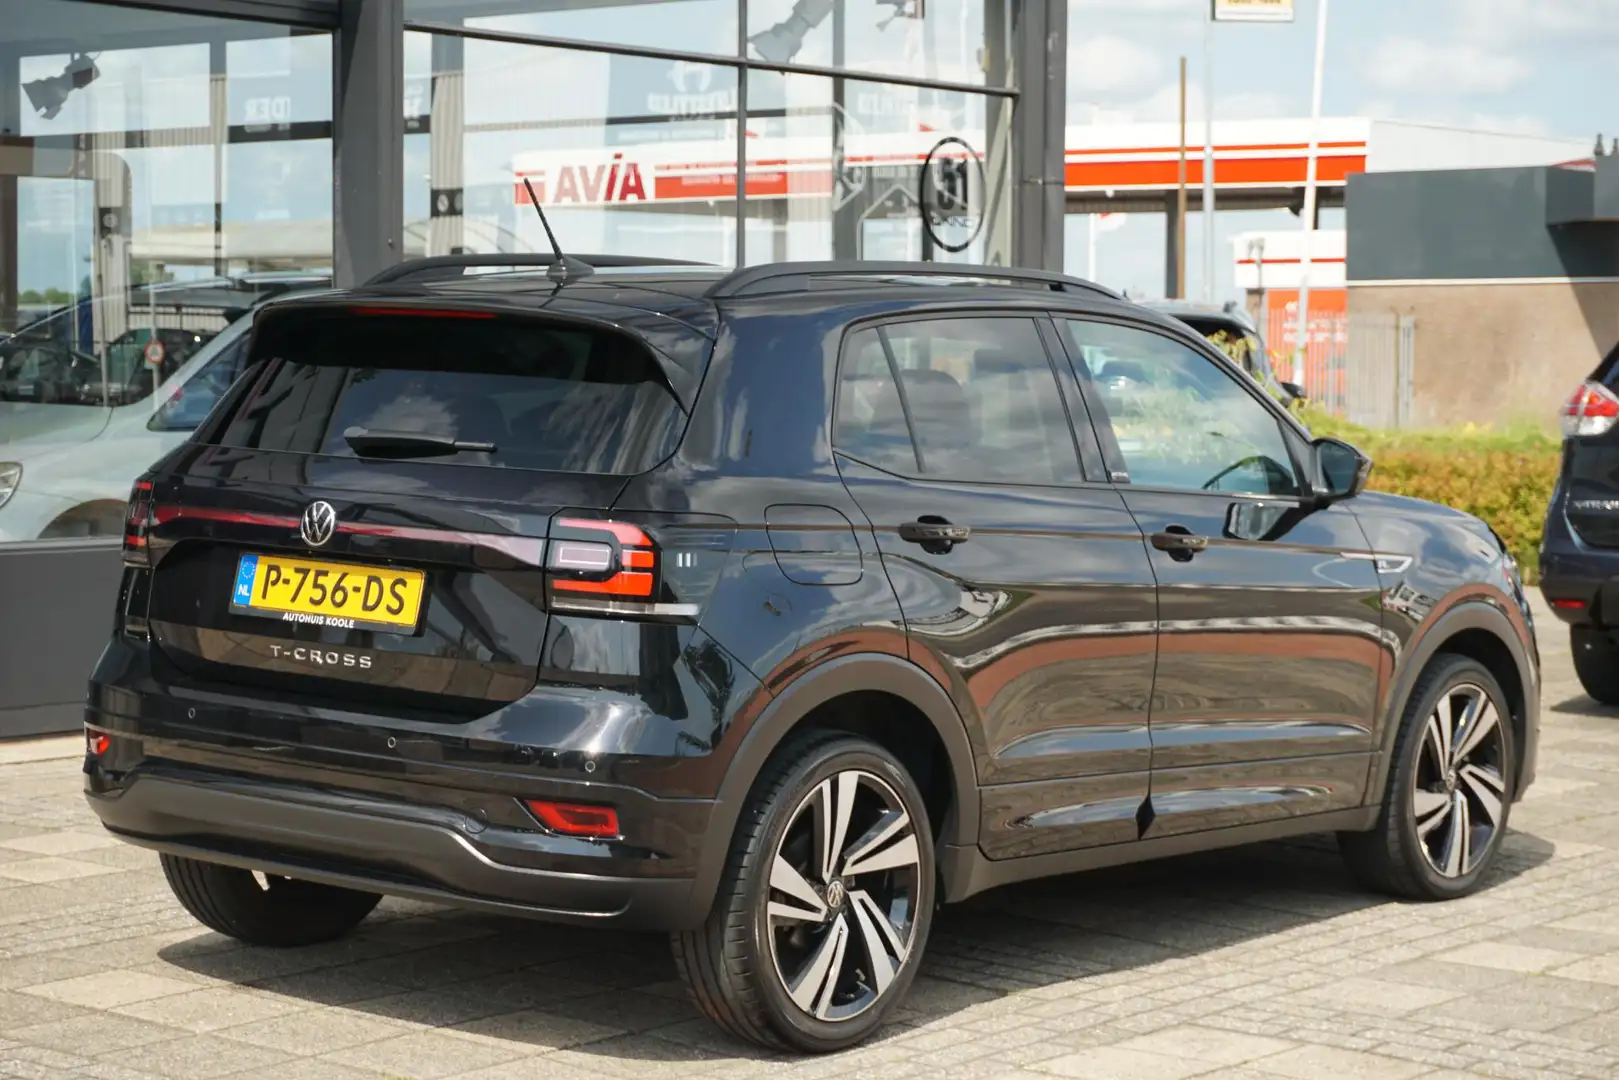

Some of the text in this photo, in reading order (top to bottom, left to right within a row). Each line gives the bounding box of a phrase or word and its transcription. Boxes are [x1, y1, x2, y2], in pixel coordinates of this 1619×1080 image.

[237, 583, 250, 597] NL
[261, 563, 408, 616] P-756-DS
[283, 612, 355, 629] AUTOHUIS KOOLE
[270, 644, 372, 669] T-CROSS
